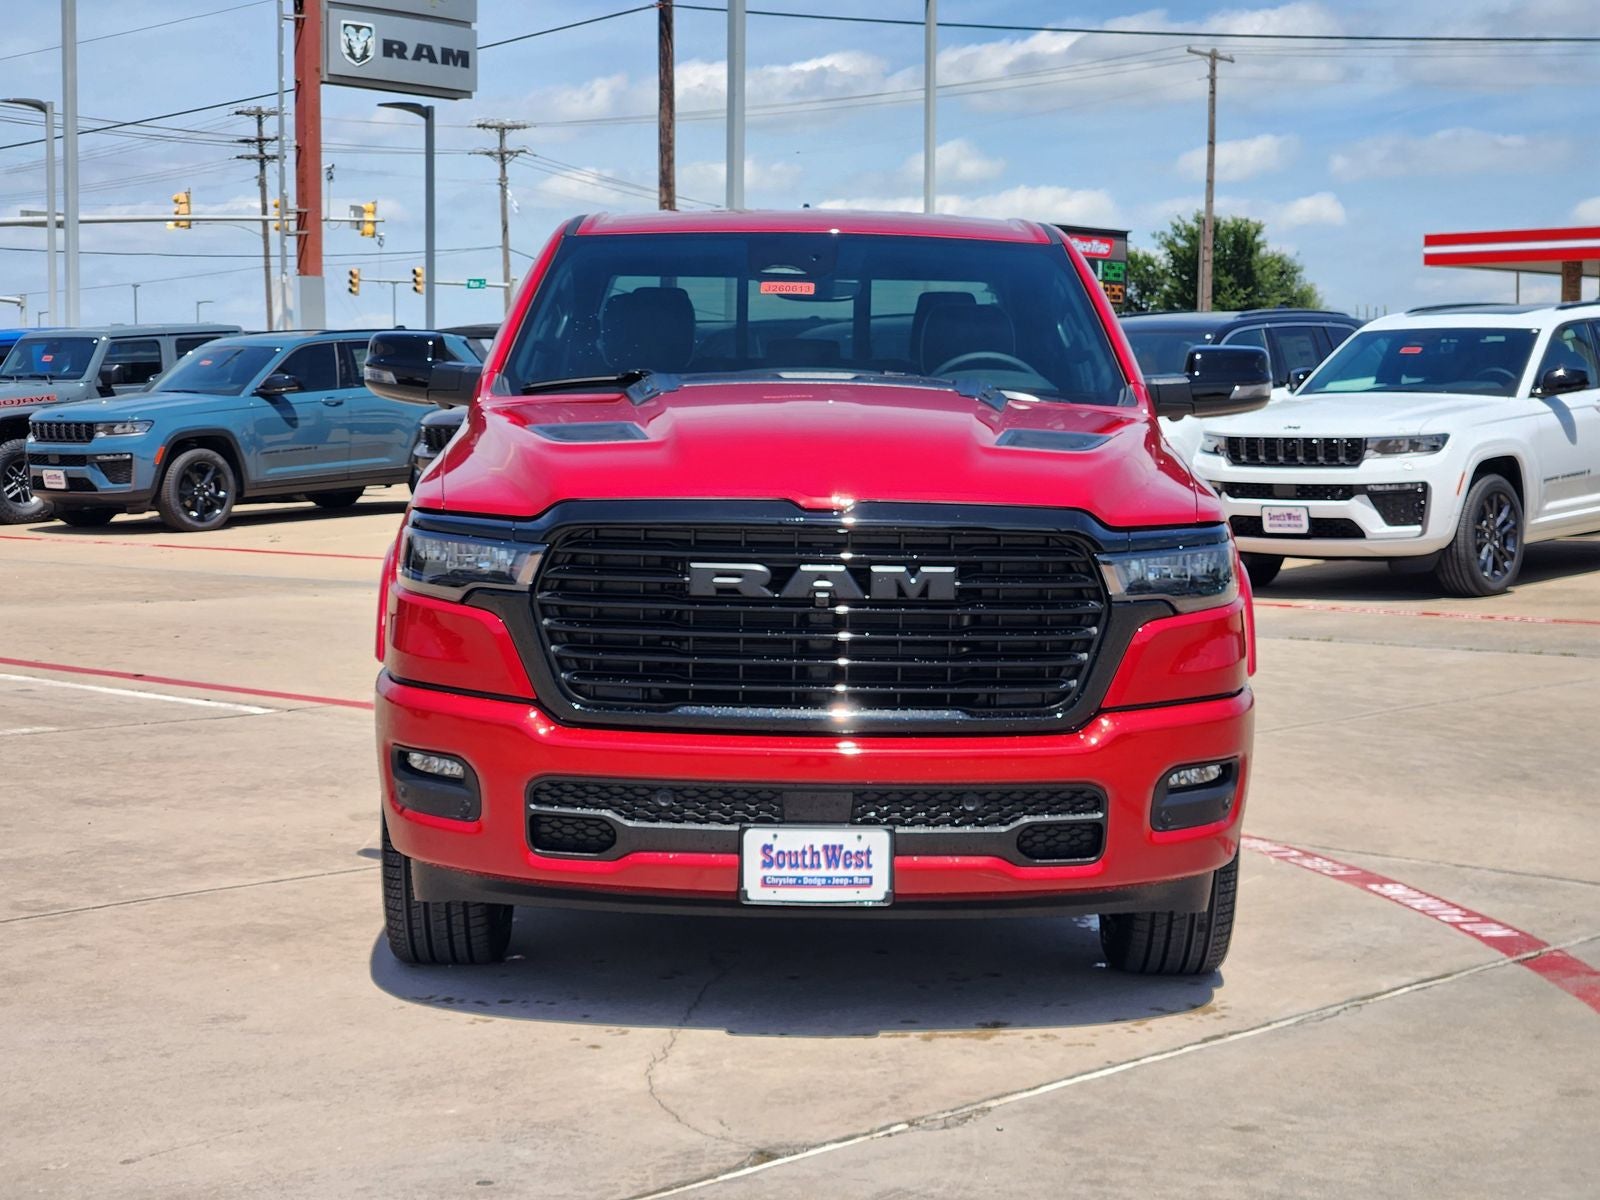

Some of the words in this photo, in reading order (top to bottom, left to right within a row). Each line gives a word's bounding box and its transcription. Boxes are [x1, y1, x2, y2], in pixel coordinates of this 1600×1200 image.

[382, 38, 470, 69] RAM
[0, 393, 57, 406] OJAVE
[689, 562, 956, 600] RAM
[761, 843, 873, 870] SouthWest
[766, 876, 797, 886] Chrysler
[803, 876, 826, 886] Dodge
[832, 876, 849, 886] Jeep
[853, 876, 870, 885] Ram
